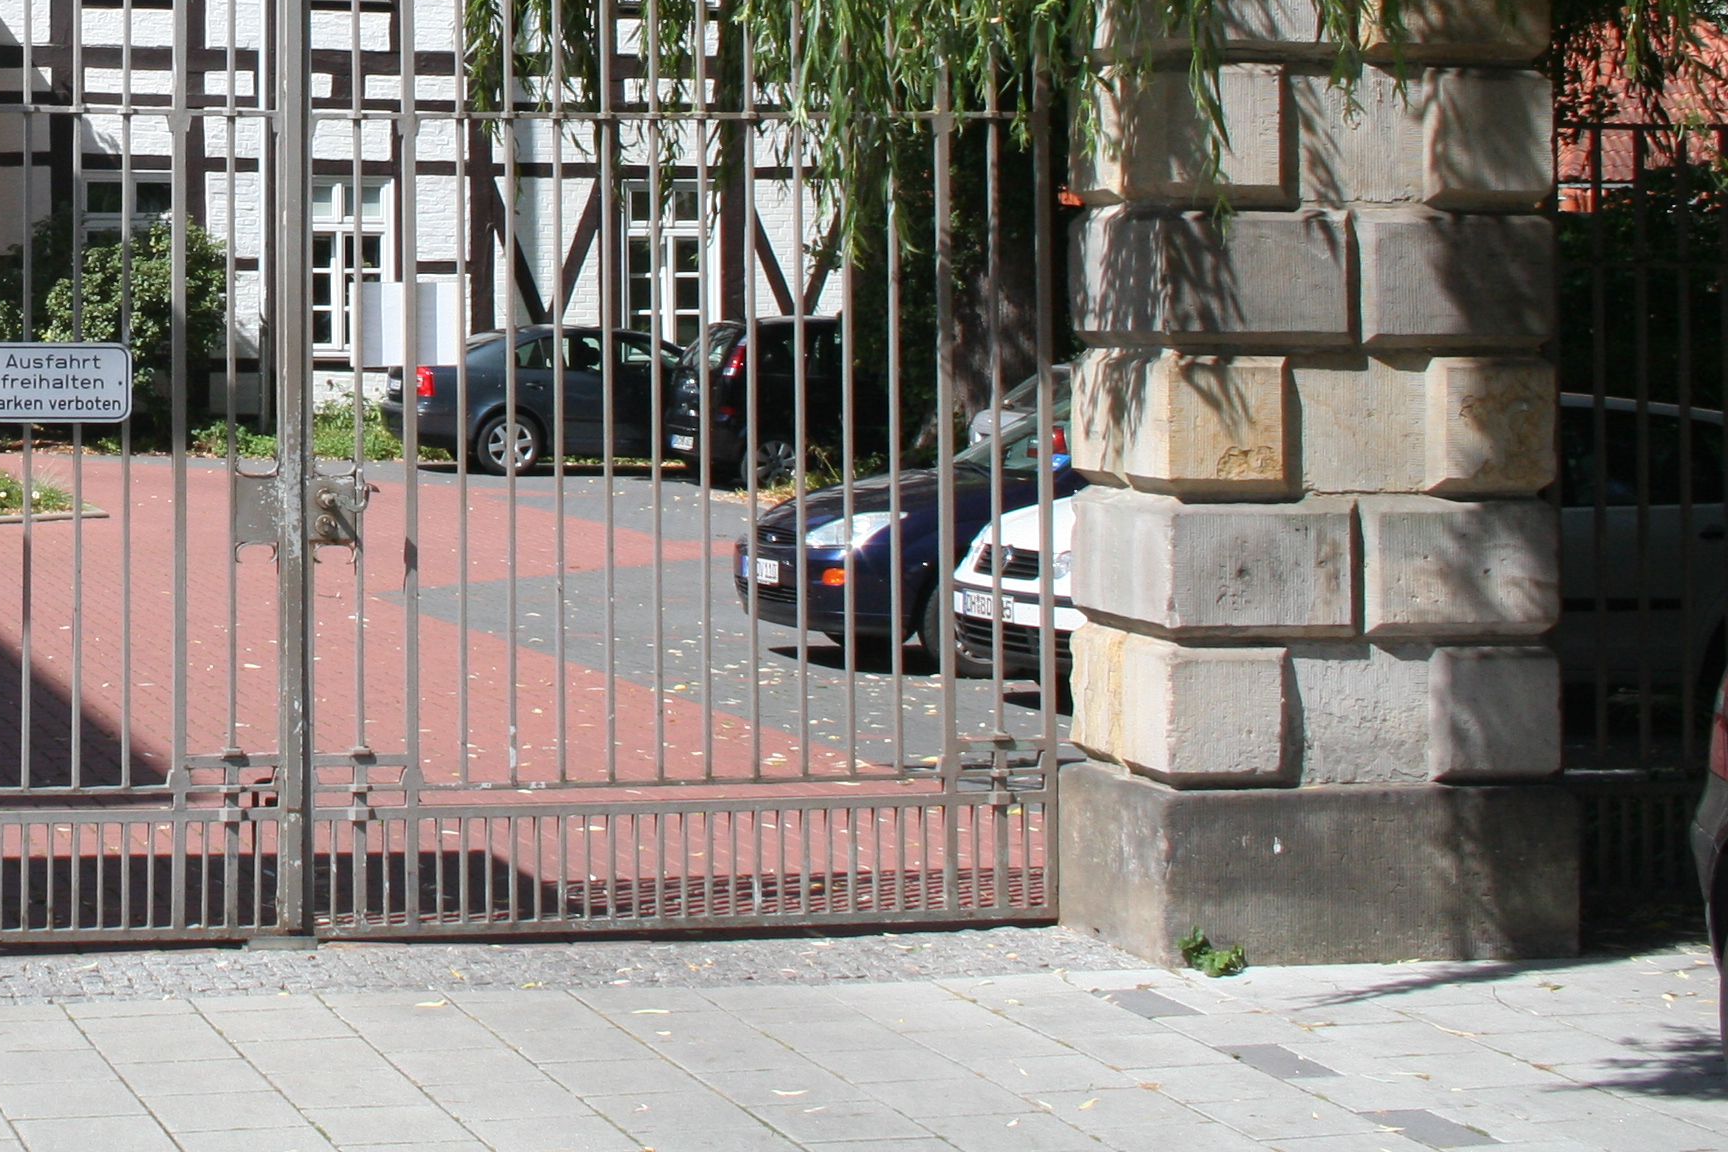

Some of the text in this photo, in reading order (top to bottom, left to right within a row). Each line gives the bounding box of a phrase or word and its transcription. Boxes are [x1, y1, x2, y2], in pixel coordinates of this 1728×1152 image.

[5, 354, 102, 370] Ausfahrt
[0, 373, 105, 390] freihalten
[49, 395, 122, 411] verboten
